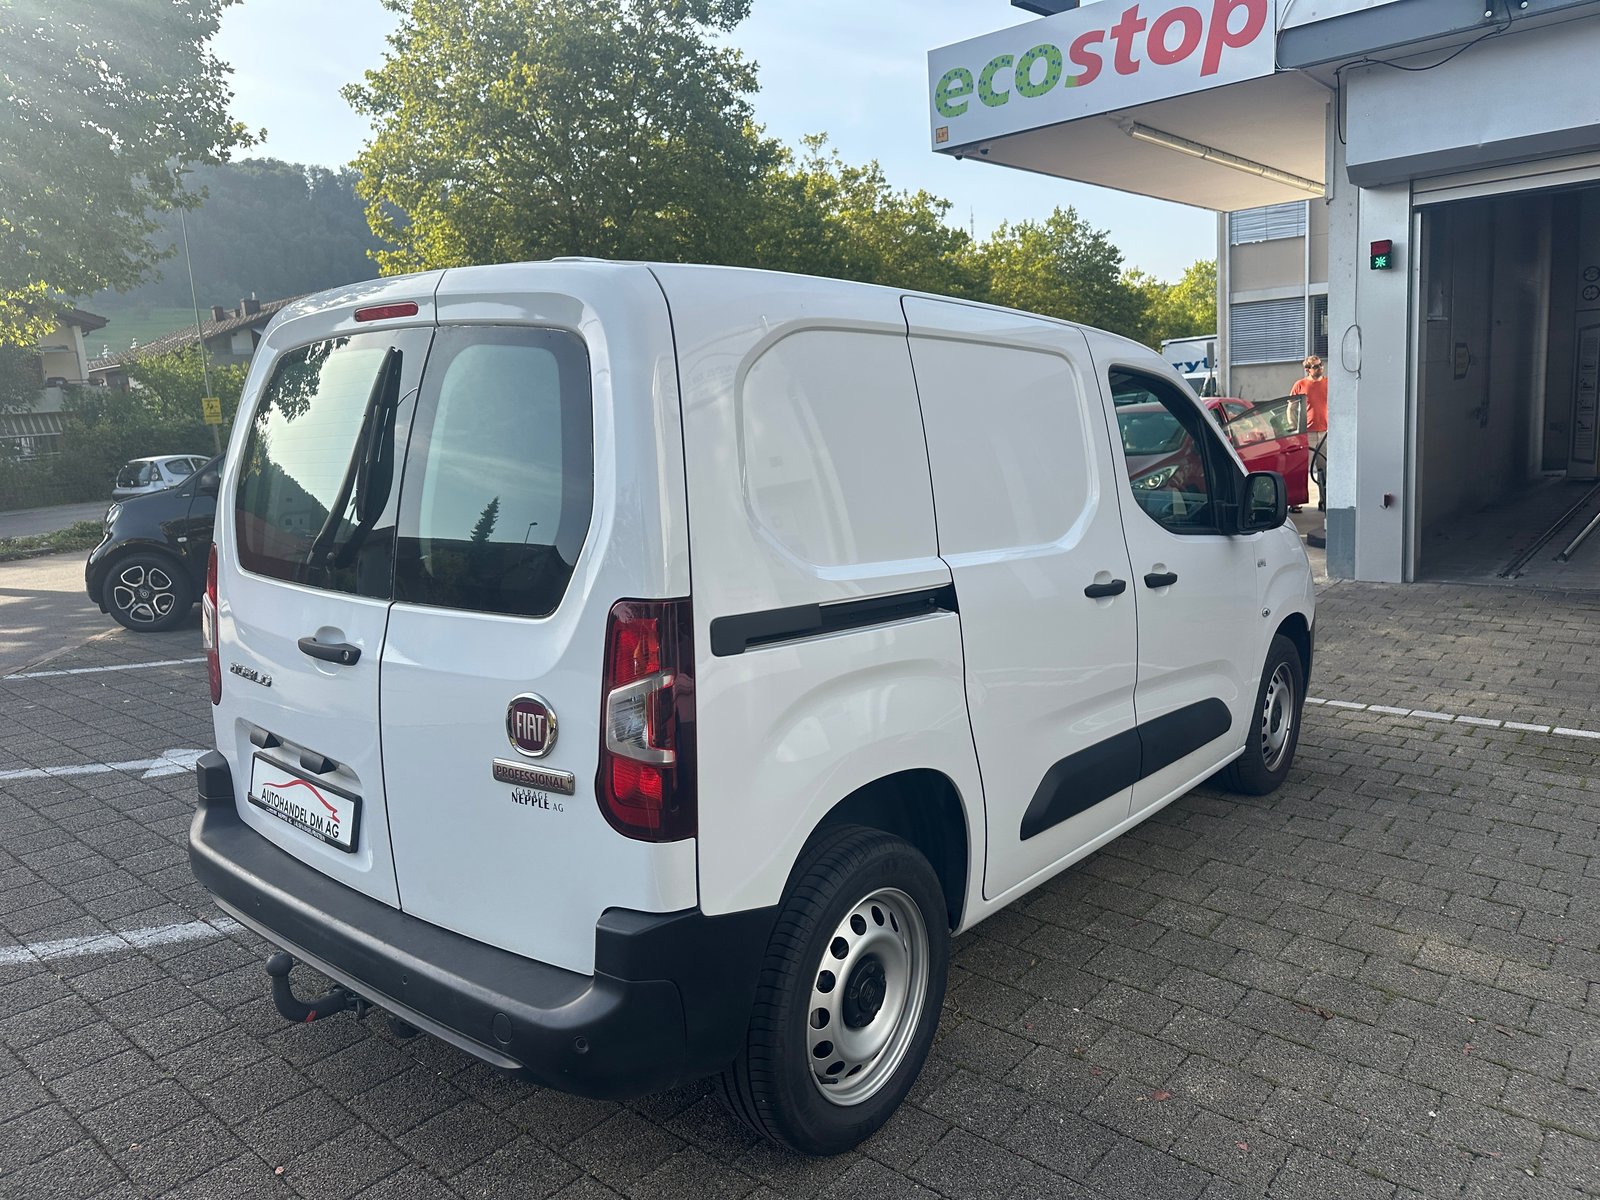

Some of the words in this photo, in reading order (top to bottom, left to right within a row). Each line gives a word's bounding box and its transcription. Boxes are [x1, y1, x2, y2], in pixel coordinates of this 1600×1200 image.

[934, 0, 1268, 118] ecostop
[516, 711, 545, 742] FIAT
[496, 765, 565, 789] PROFESSIONAL
[261, 788, 307, 823] AUTOHANDEL
[310, 812, 324, 832] DM
[325, 821, 340, 838] AG
[511, 791, 550, 810] NEPPLE
[553, 803, 564, 812] AG
